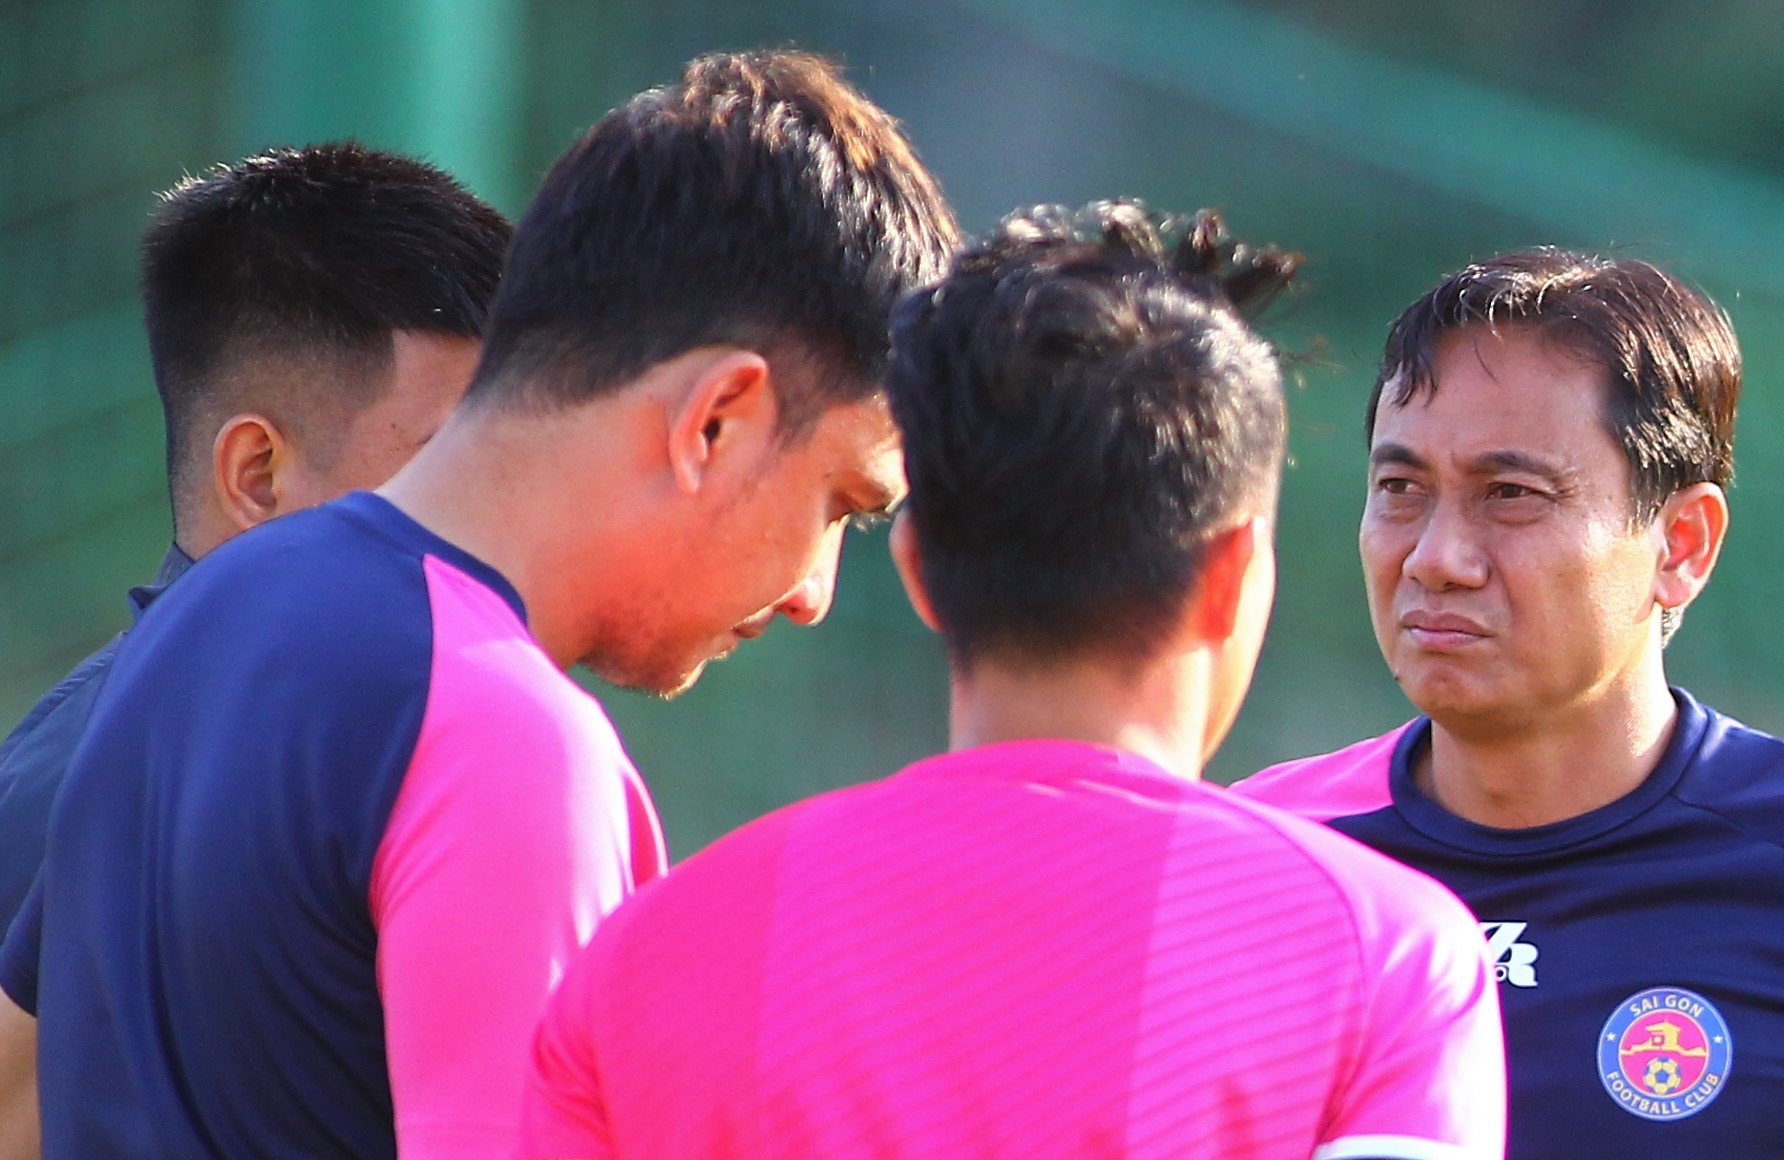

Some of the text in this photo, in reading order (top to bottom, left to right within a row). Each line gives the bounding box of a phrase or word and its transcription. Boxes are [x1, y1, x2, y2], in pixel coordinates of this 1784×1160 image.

[1629, 994, 1704, 1018] SAI GON
[1606, 1070, 1721, 1114] FOOTBALL CLUB
